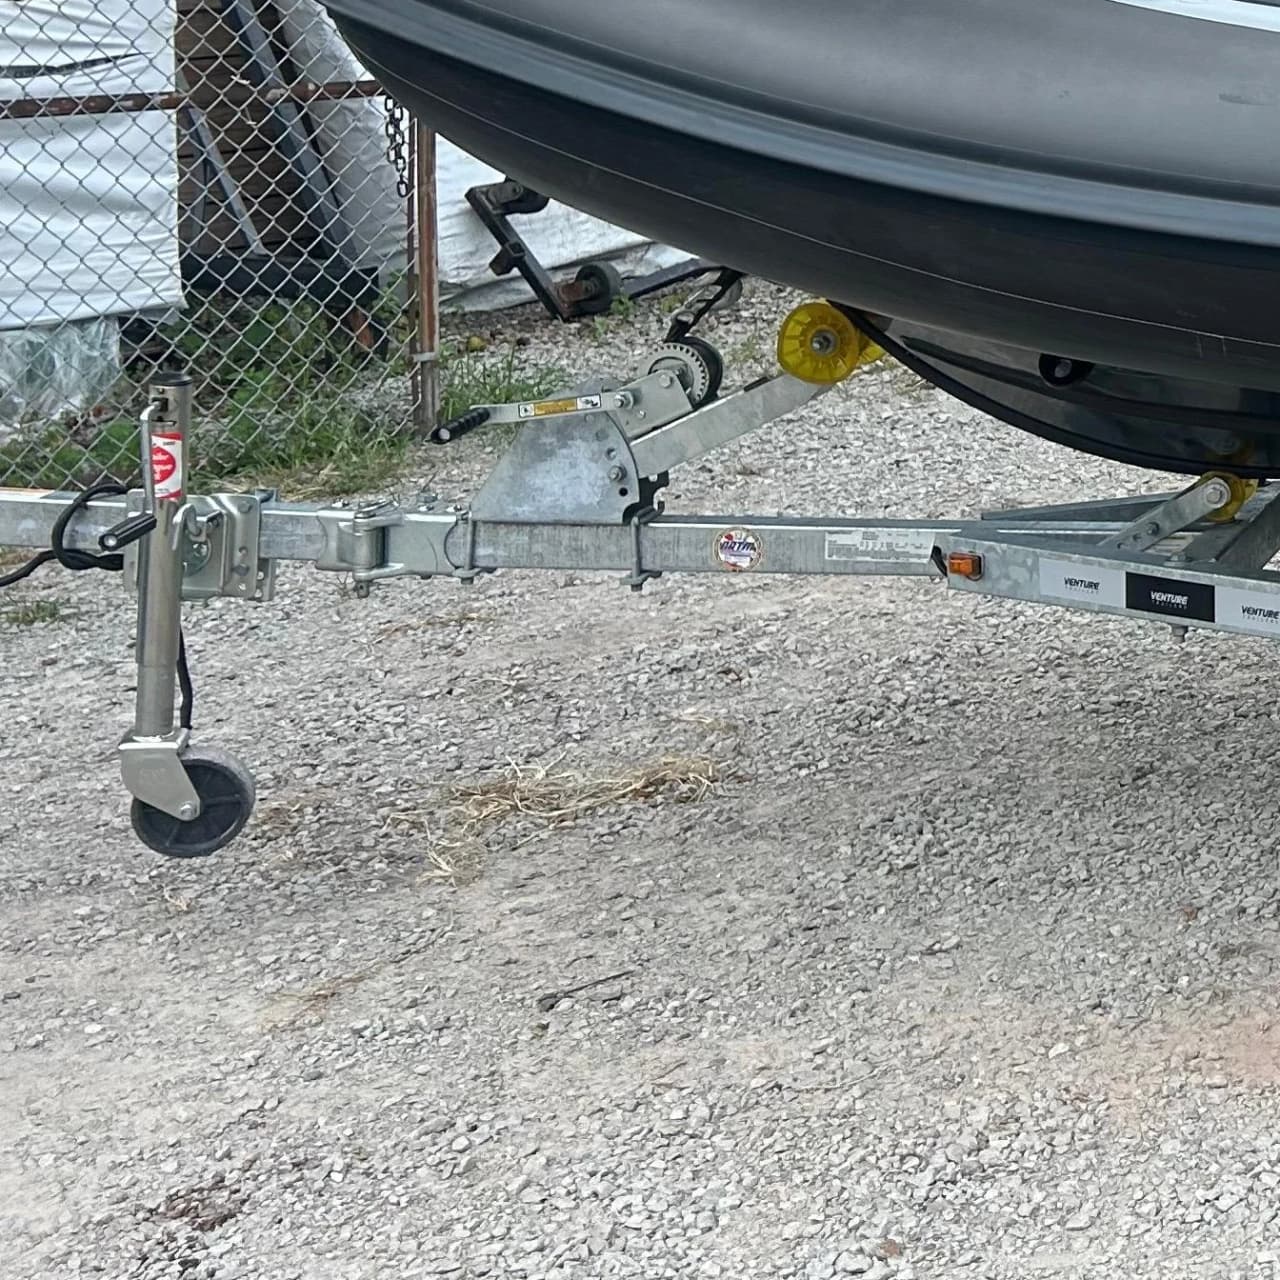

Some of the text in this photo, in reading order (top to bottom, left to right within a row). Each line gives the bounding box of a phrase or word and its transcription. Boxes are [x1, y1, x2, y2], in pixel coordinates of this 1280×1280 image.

[1063, 576, 1101, 591] VENTURE
[1150, 591, 1189, 606] VENTURE
[1241, 605, 1280, 620] VENTURE
